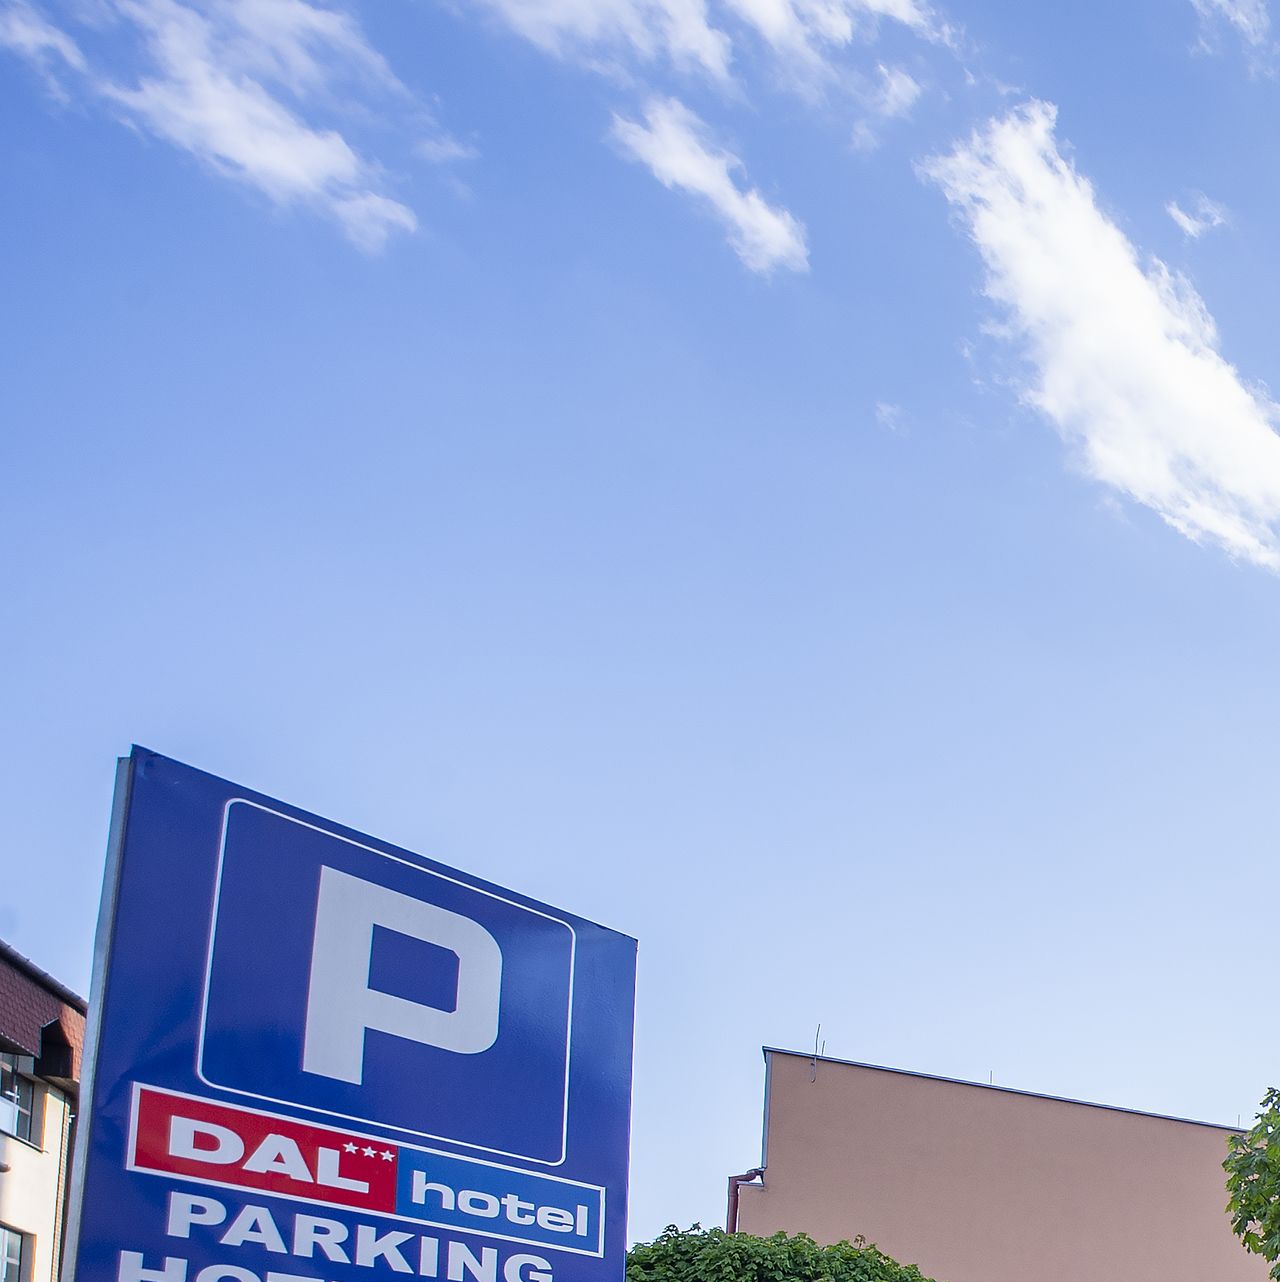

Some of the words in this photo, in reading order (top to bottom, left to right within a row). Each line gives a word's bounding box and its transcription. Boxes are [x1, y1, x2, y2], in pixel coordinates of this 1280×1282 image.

[302, 864, 503, 1085] P
[167, 1115, 370, 1194] DAL
[411, 1169, 589, 1237] hotel
